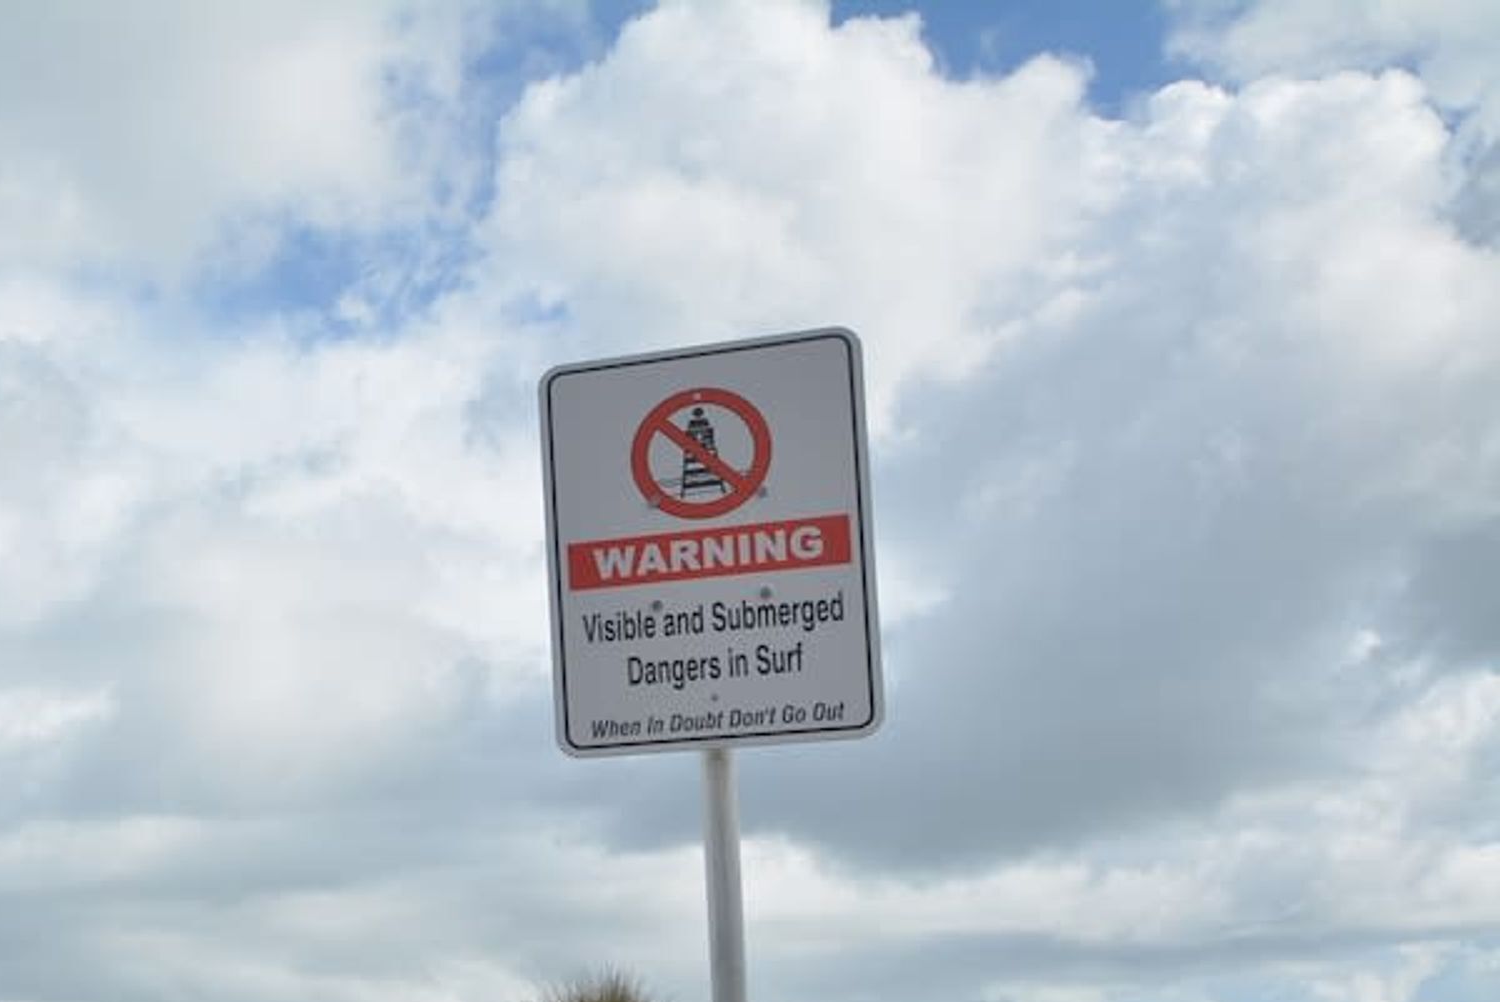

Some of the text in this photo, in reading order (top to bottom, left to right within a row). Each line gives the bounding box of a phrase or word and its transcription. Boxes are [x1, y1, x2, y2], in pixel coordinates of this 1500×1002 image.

[592, 525, 824, 580] WARNING
[582, 590, 844, 644] Visible and Submerged
[627, 641, 803, 690] Dangers in Surf
[592, 701, 844, 739] When In Doubt Don't Go Out
